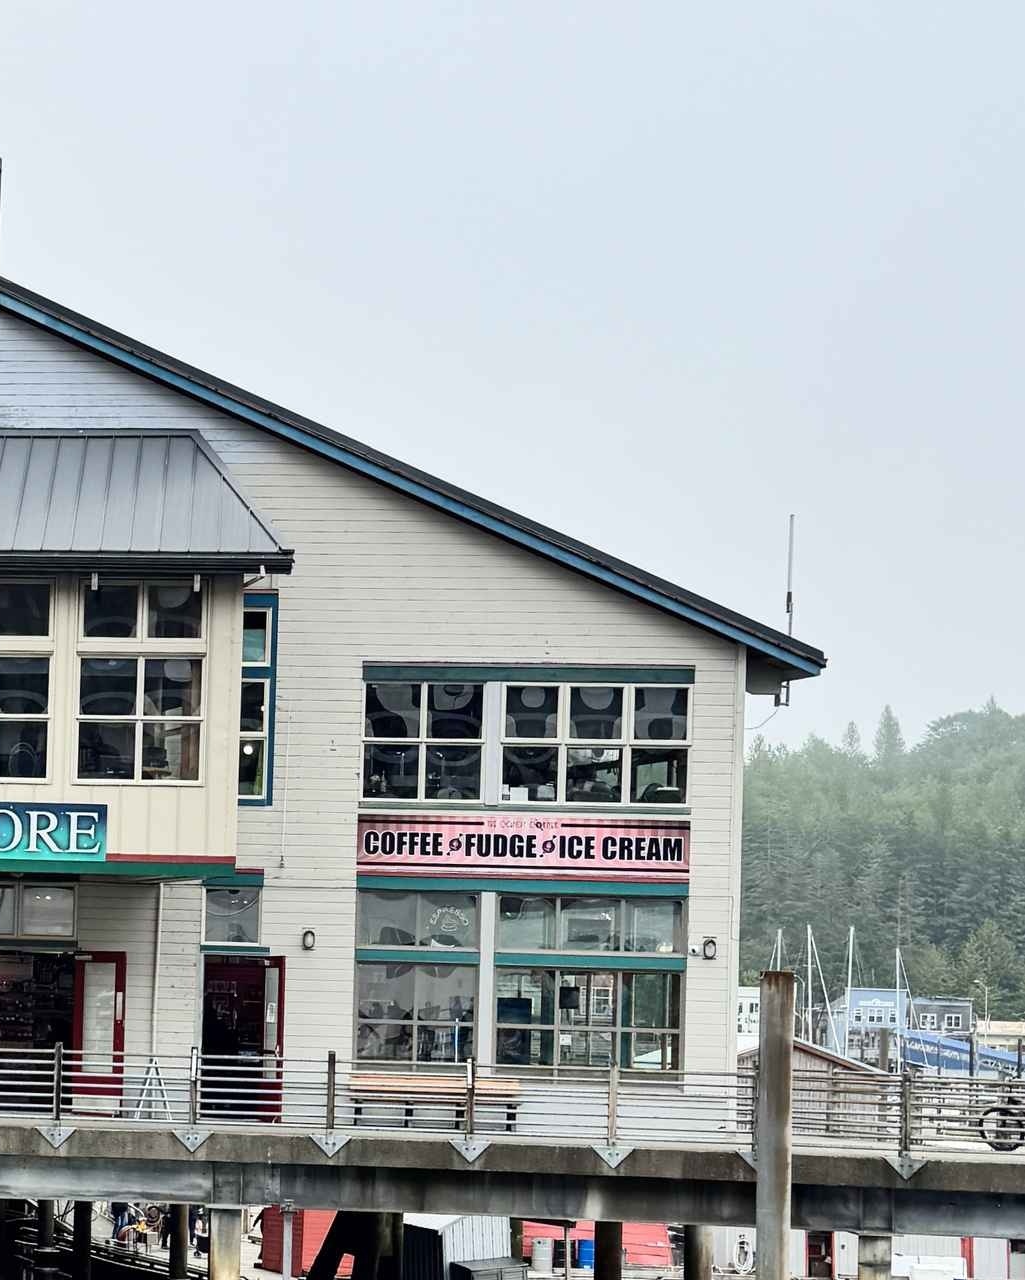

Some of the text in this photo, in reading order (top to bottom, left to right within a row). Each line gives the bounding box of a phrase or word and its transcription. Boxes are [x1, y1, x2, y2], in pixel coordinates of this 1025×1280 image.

[364, 830, 683, 862] COFFEE FUDGE ICE CREAM
